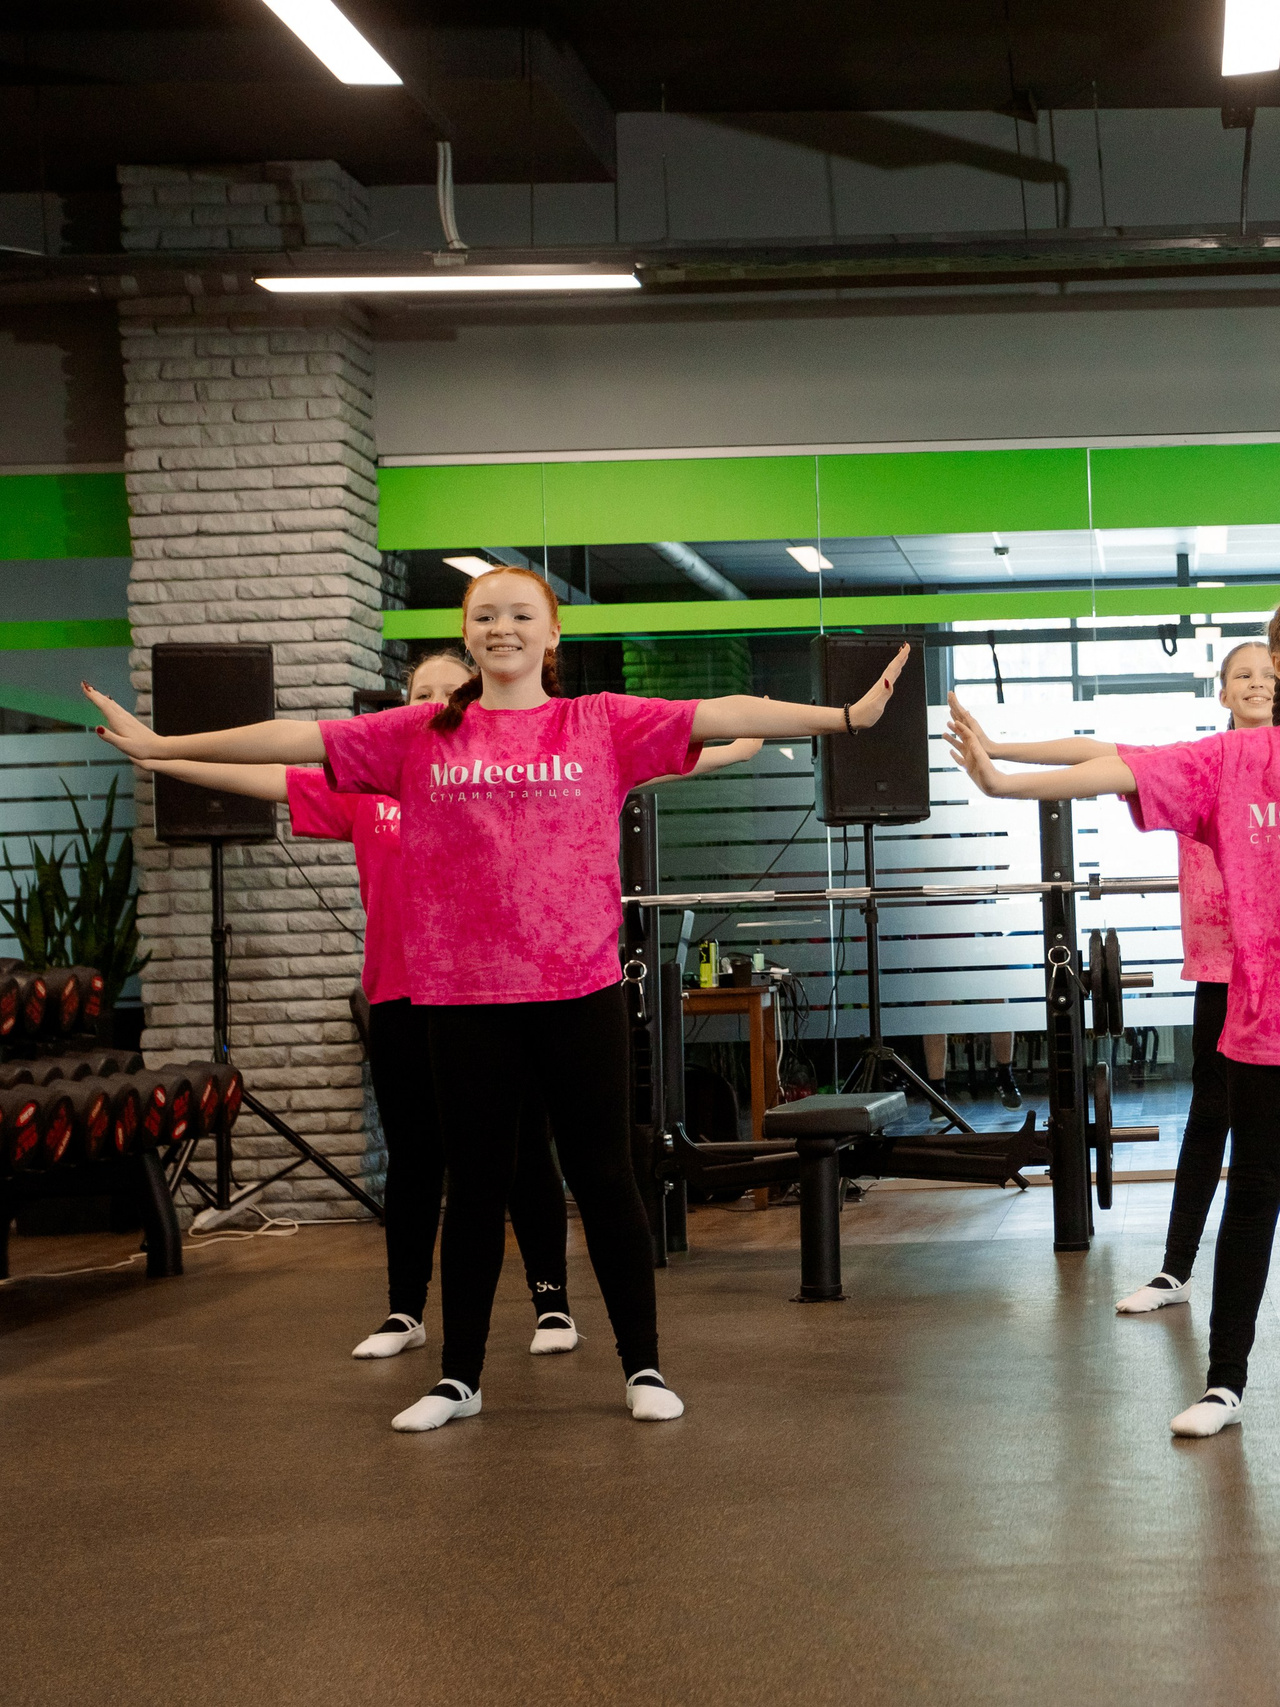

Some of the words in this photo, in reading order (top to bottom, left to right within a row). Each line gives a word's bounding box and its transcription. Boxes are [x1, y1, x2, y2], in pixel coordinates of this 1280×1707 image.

[429, 754, 583, 787] Molecule
[430, 790, 493, 803] Студия
[508, 787, 582, 799] танцев
